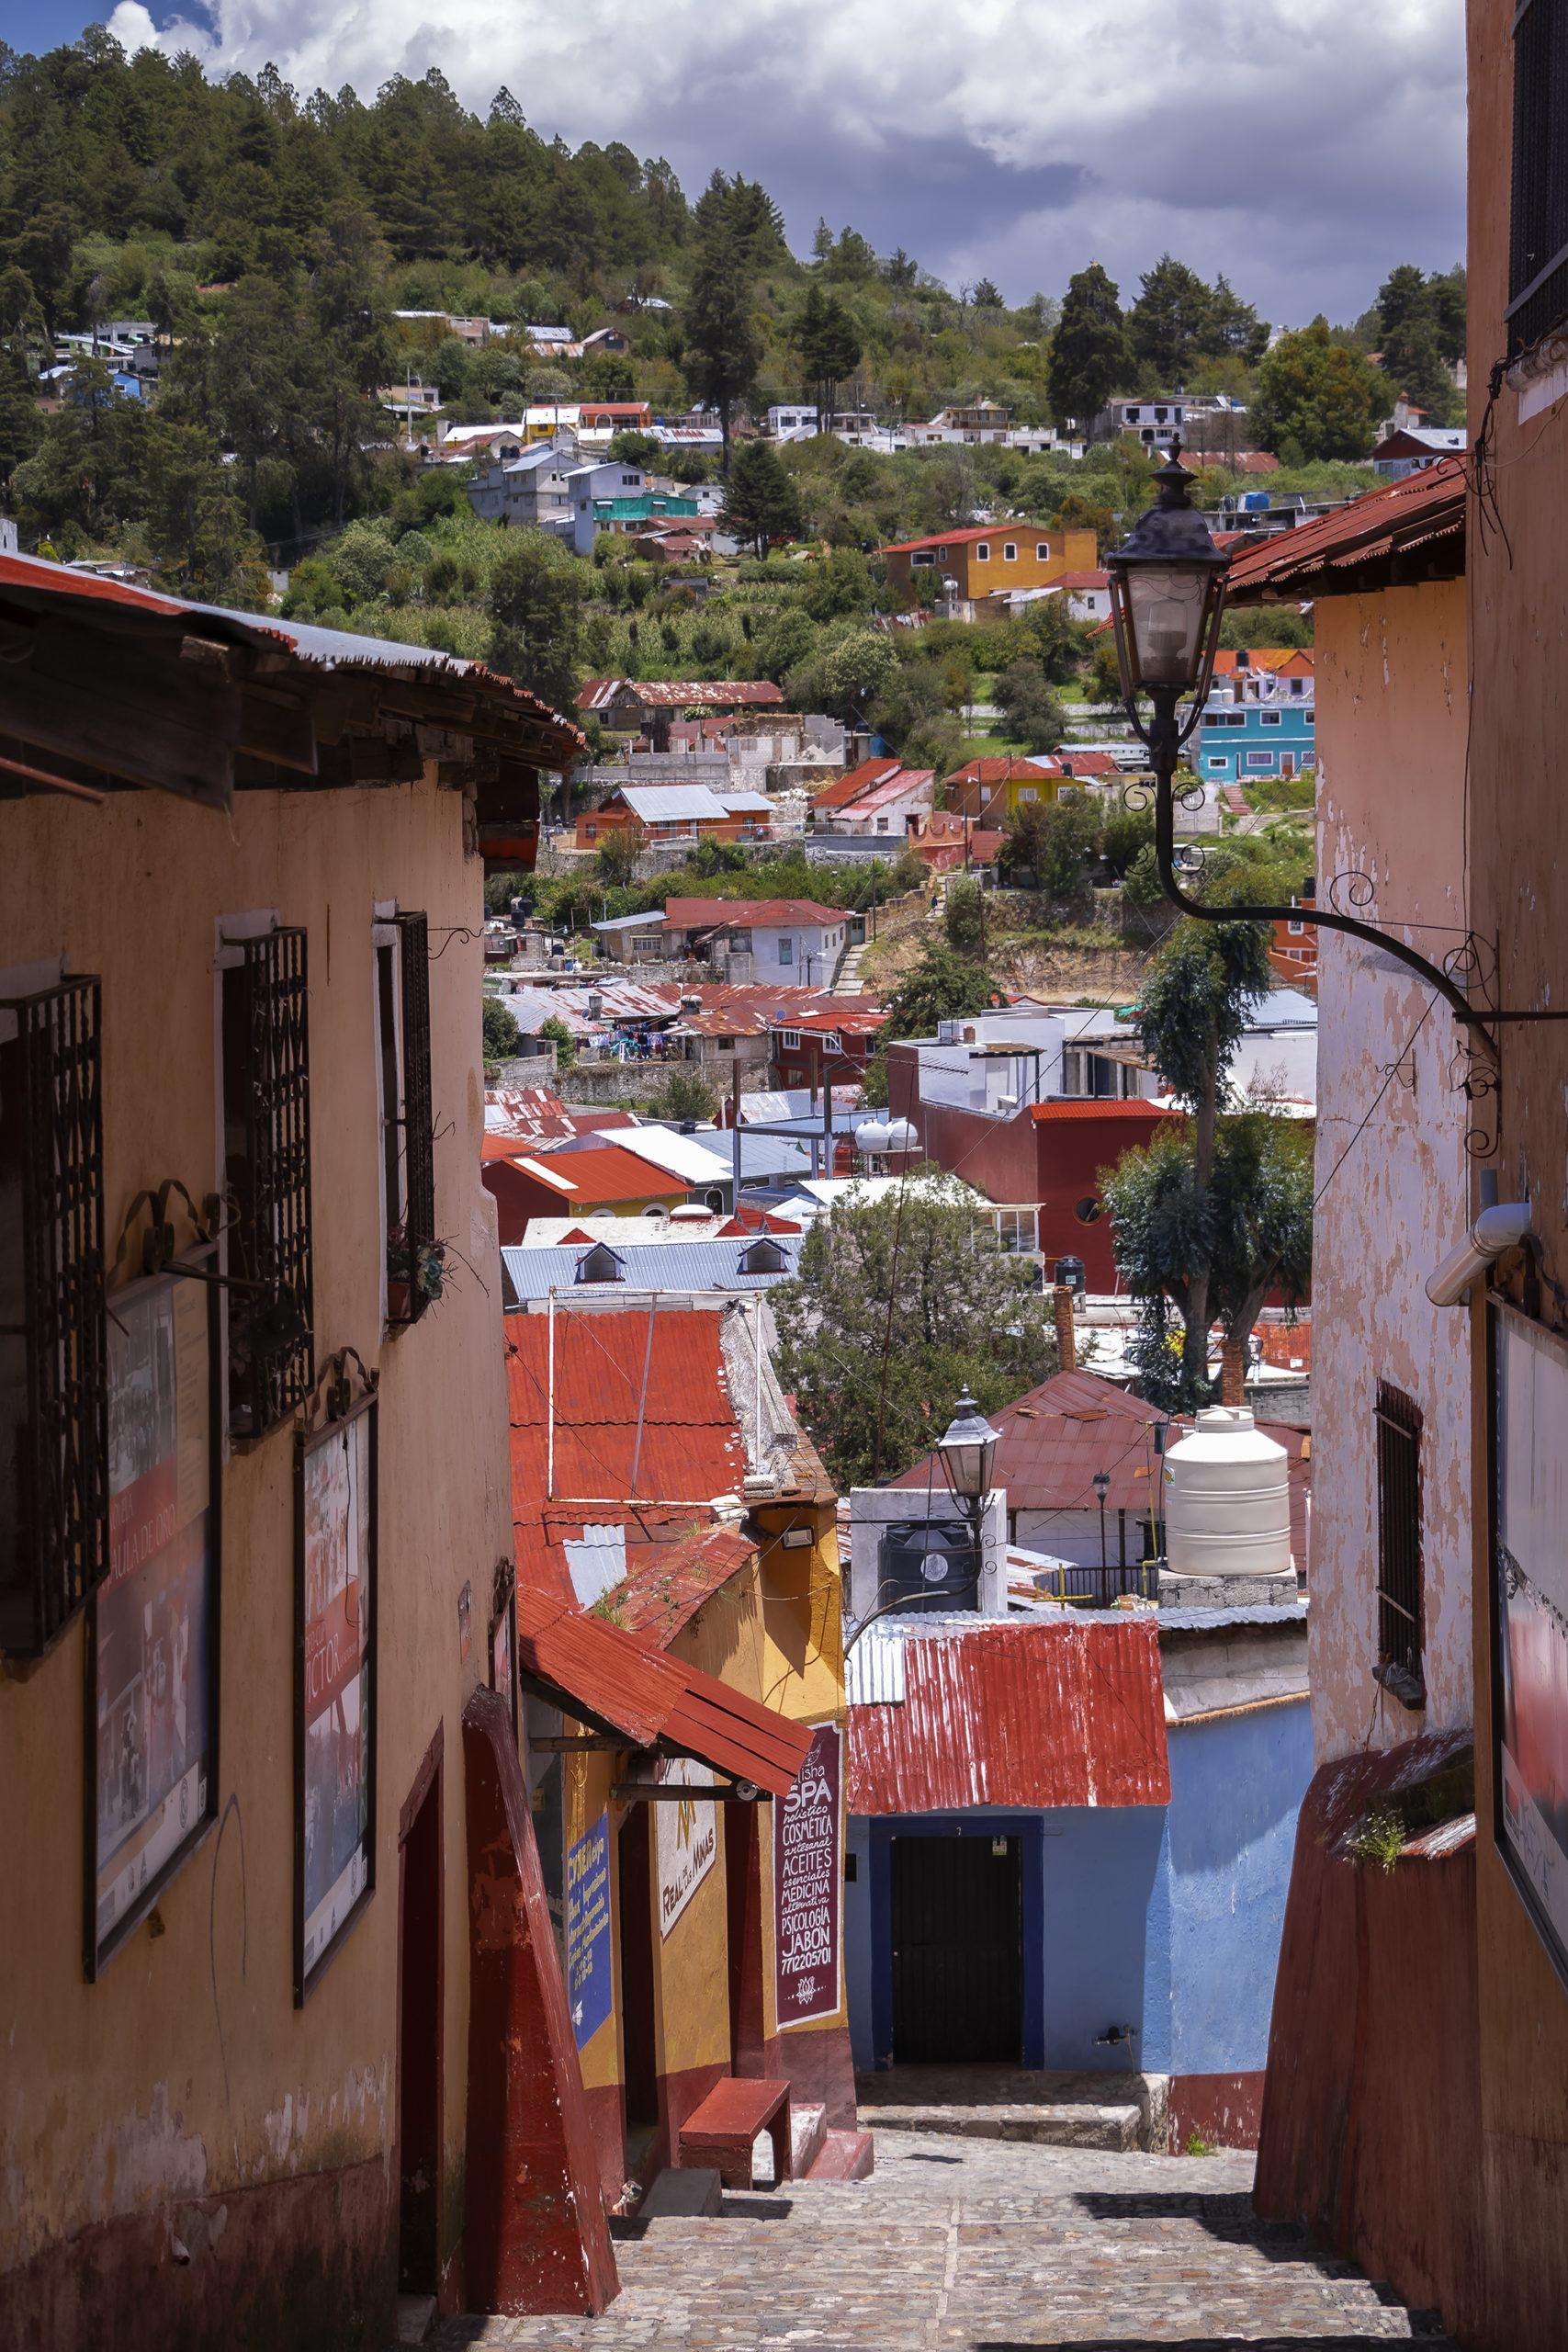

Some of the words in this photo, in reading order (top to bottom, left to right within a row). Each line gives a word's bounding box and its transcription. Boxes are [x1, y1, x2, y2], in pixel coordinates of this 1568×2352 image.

[107, 1532, 139, 1592] AULA
[141, 1521, 153, 1560] DE
[794, 1765, 825, 1783] lisha
[783, 1778, 832, 1813] SPA
[783, 1814, 833, 1847] COSMÉTICA
[784, 1838, 832, 1856] artesanal
[568, 1838, 592, 1890] CYBER
[662, 1875, 682, 1924] REAL
[682, 1871, 693, 1891] LAS
[692, 1828, 715, 1877] MINAS
[783, 1848, 832, 1878] ACEITES
[781, 1879, 830, 1905] MEDICINA
[783, 1869, 829, 1888] esenciales
[782, 1894, 830, 1915] alternativa
[781, 1905, 830, 1937] PSICOLOGÍA
[782, 1926, 830, 1957] JABÓN
[781, 1947, 831, 1976] 7712205701
